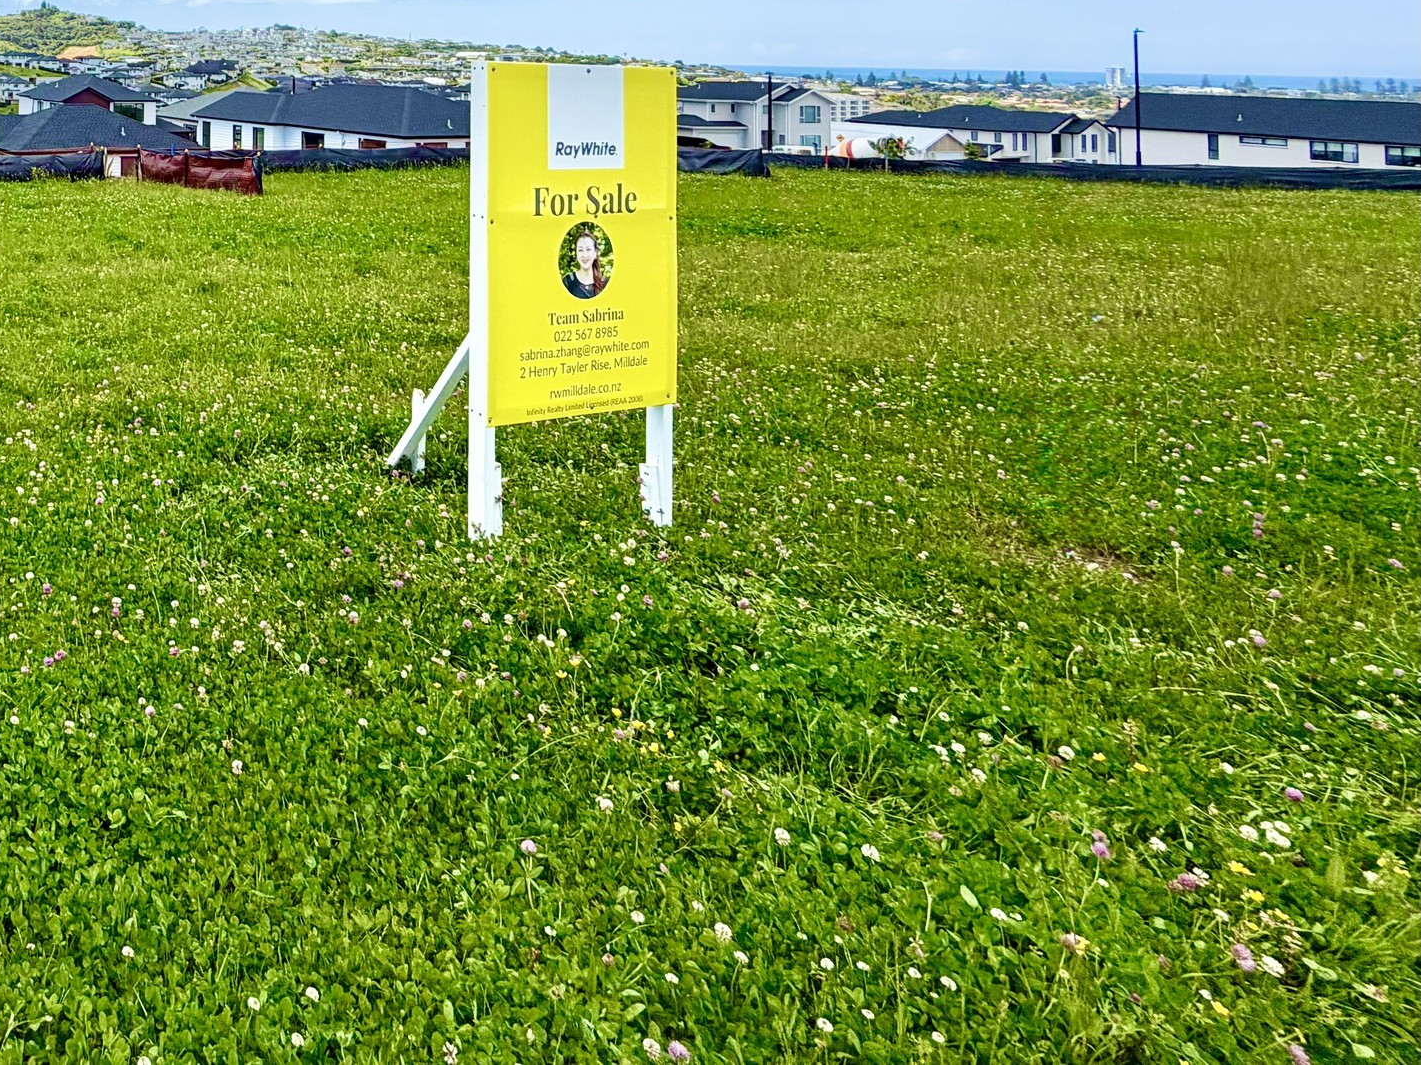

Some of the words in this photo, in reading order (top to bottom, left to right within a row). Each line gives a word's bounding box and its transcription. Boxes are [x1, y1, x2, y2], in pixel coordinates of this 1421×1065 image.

[533, 187, 579, 216] For
[586, 183, 637, 216] Sale
[548, 313, 579, 326] Team
[582, 308, 624, 323] Sabrina
[554, 330, 572, 342] 022
[575, 328, 593, 340] 567
[595, 326, 618, 338] 8985
[520, 341, 649, 361] sabrina.zhang@raywhite.com
[520, 367, 526, 379] 2
[529, 366, 557, 377] Henry
[560, 362, 588, 375] Tayler
[591, 360, 611, 371] Rise,
[614, 355, 647, 368] Milldale
[550, 383, 621, 399] rwmilldale.co.nz
[526, 406, 545, 416] Infinity
[547, 405, 564, 414] Realty
[565, 403, 584, 411] Limited
[586, 400, 609, 409] Licensed
[610, 398, 627, 406] (REAA
